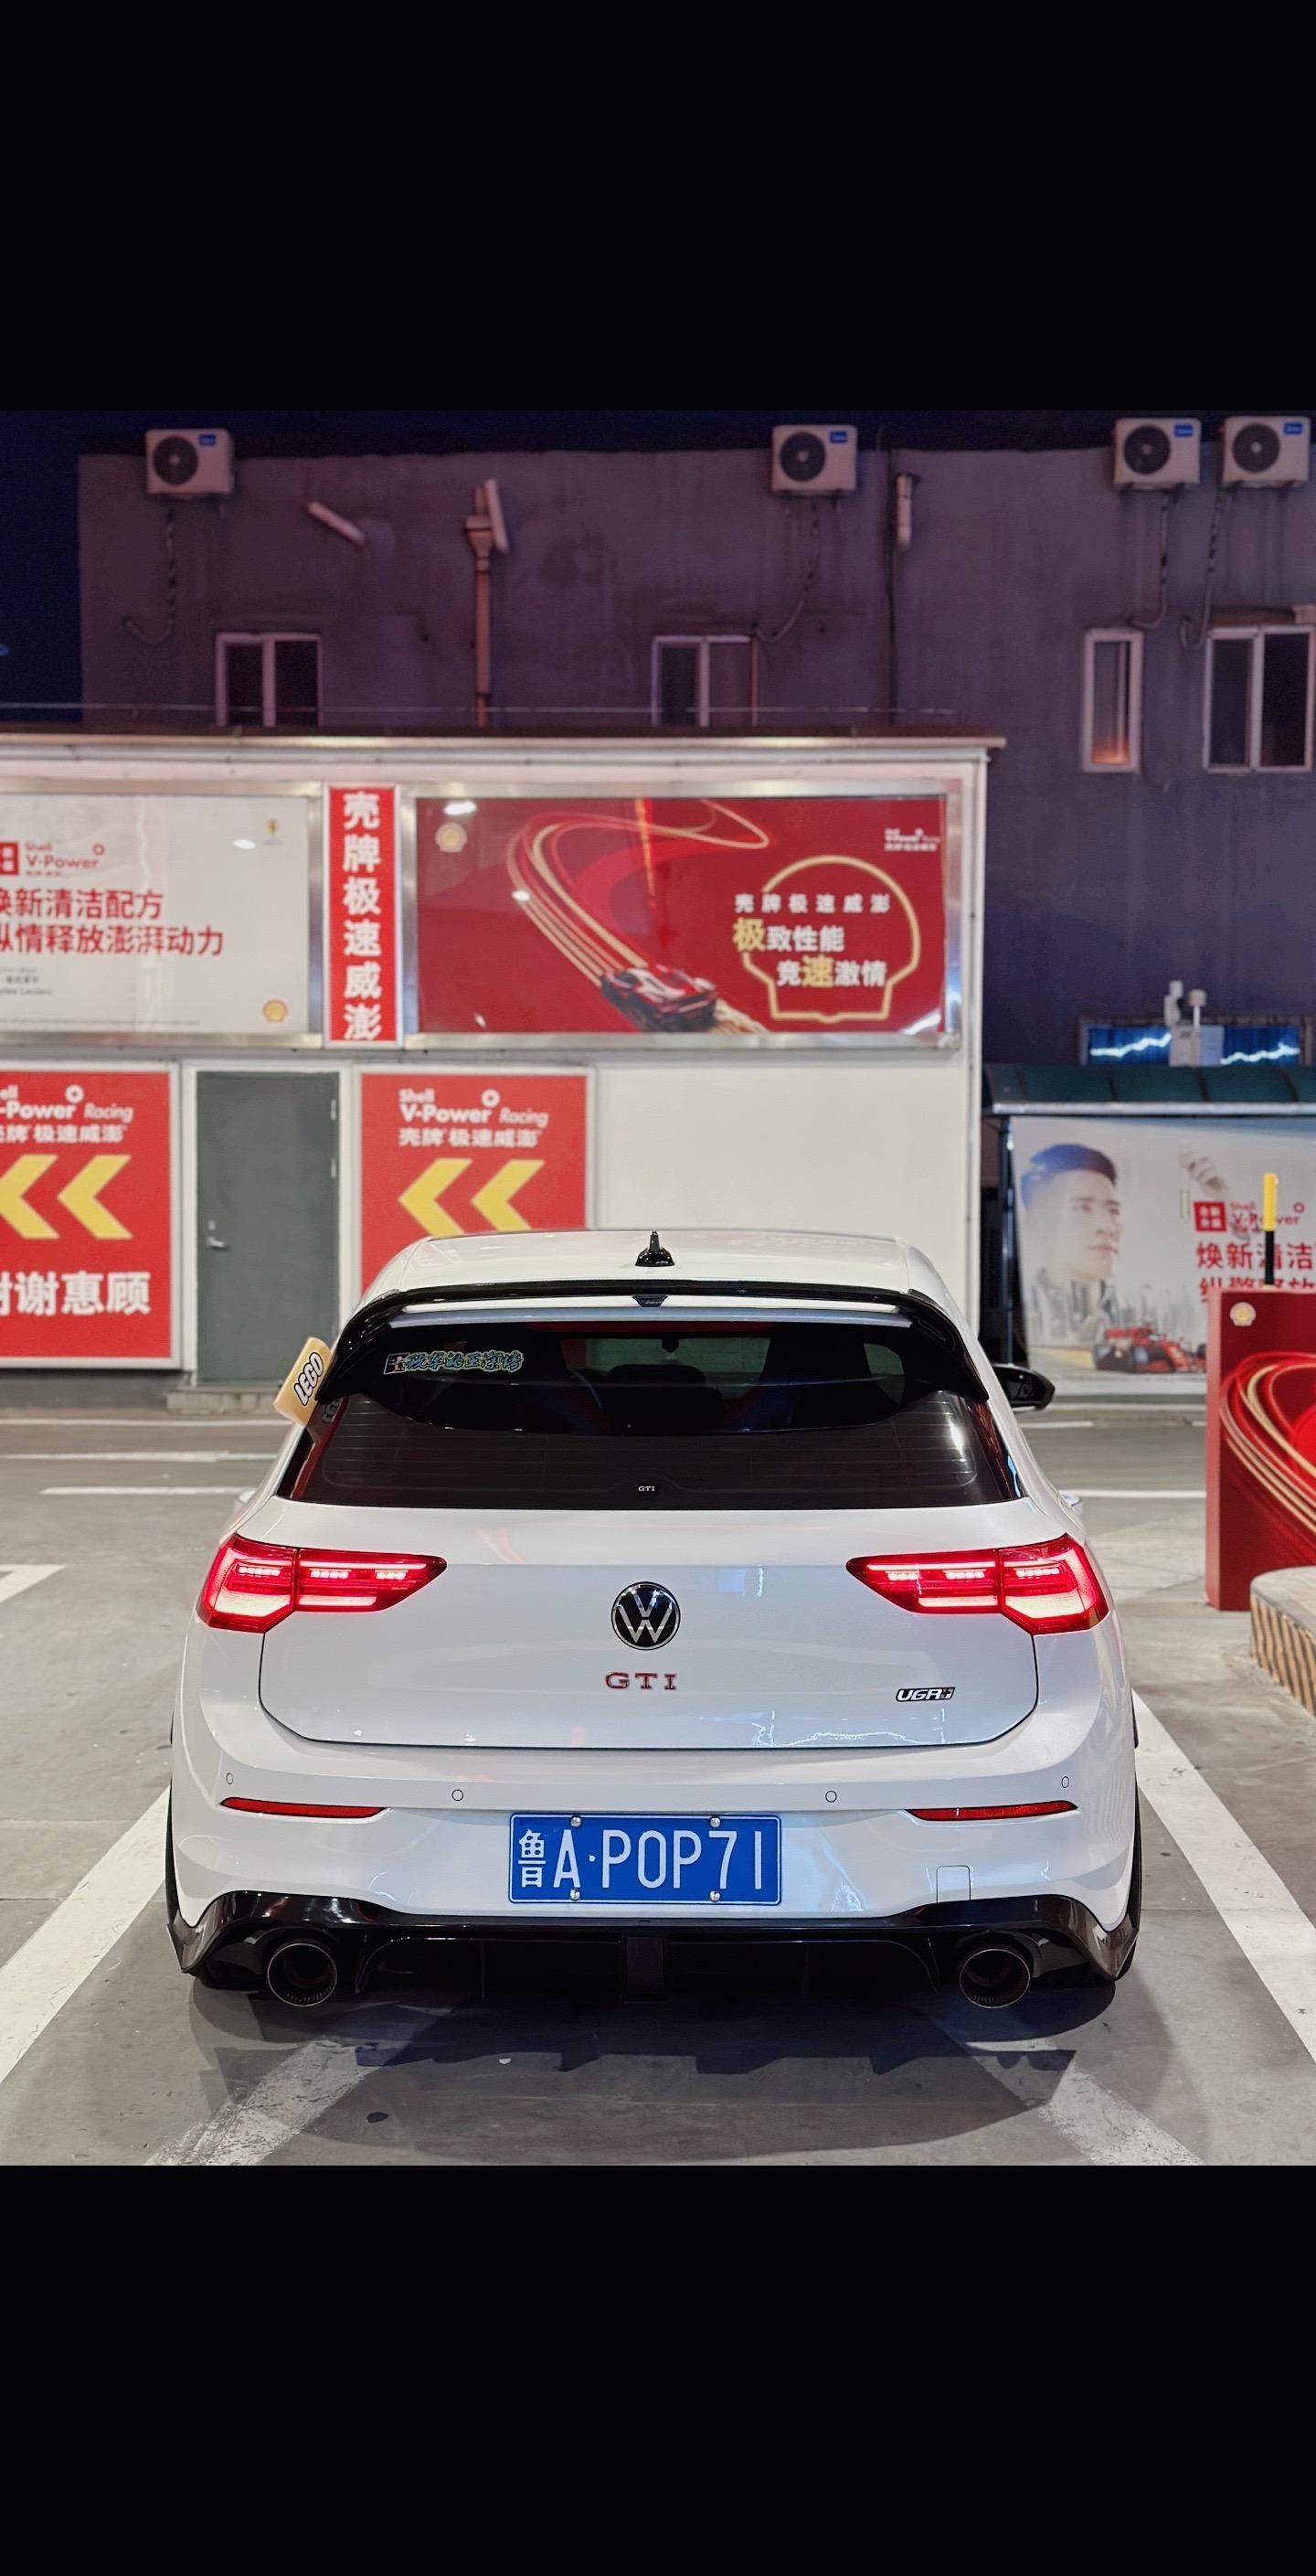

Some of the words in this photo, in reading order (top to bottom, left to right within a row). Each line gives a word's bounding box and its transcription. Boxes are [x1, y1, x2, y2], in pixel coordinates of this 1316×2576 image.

[343, 792, 382, 1041] 壳牌极速威澎
[733, 917, 844, 952] 极致性能
[83, 1102, 134, 1123] Racing
[399, 1104, 493, 1123] V-Power
[499, 1107, 549, 1129] Racing
[293, 1351, 324, 1406] LEGO
[637, 1485, 655, 1493] GTI
[604, 1671, 677, 1692] GTI
